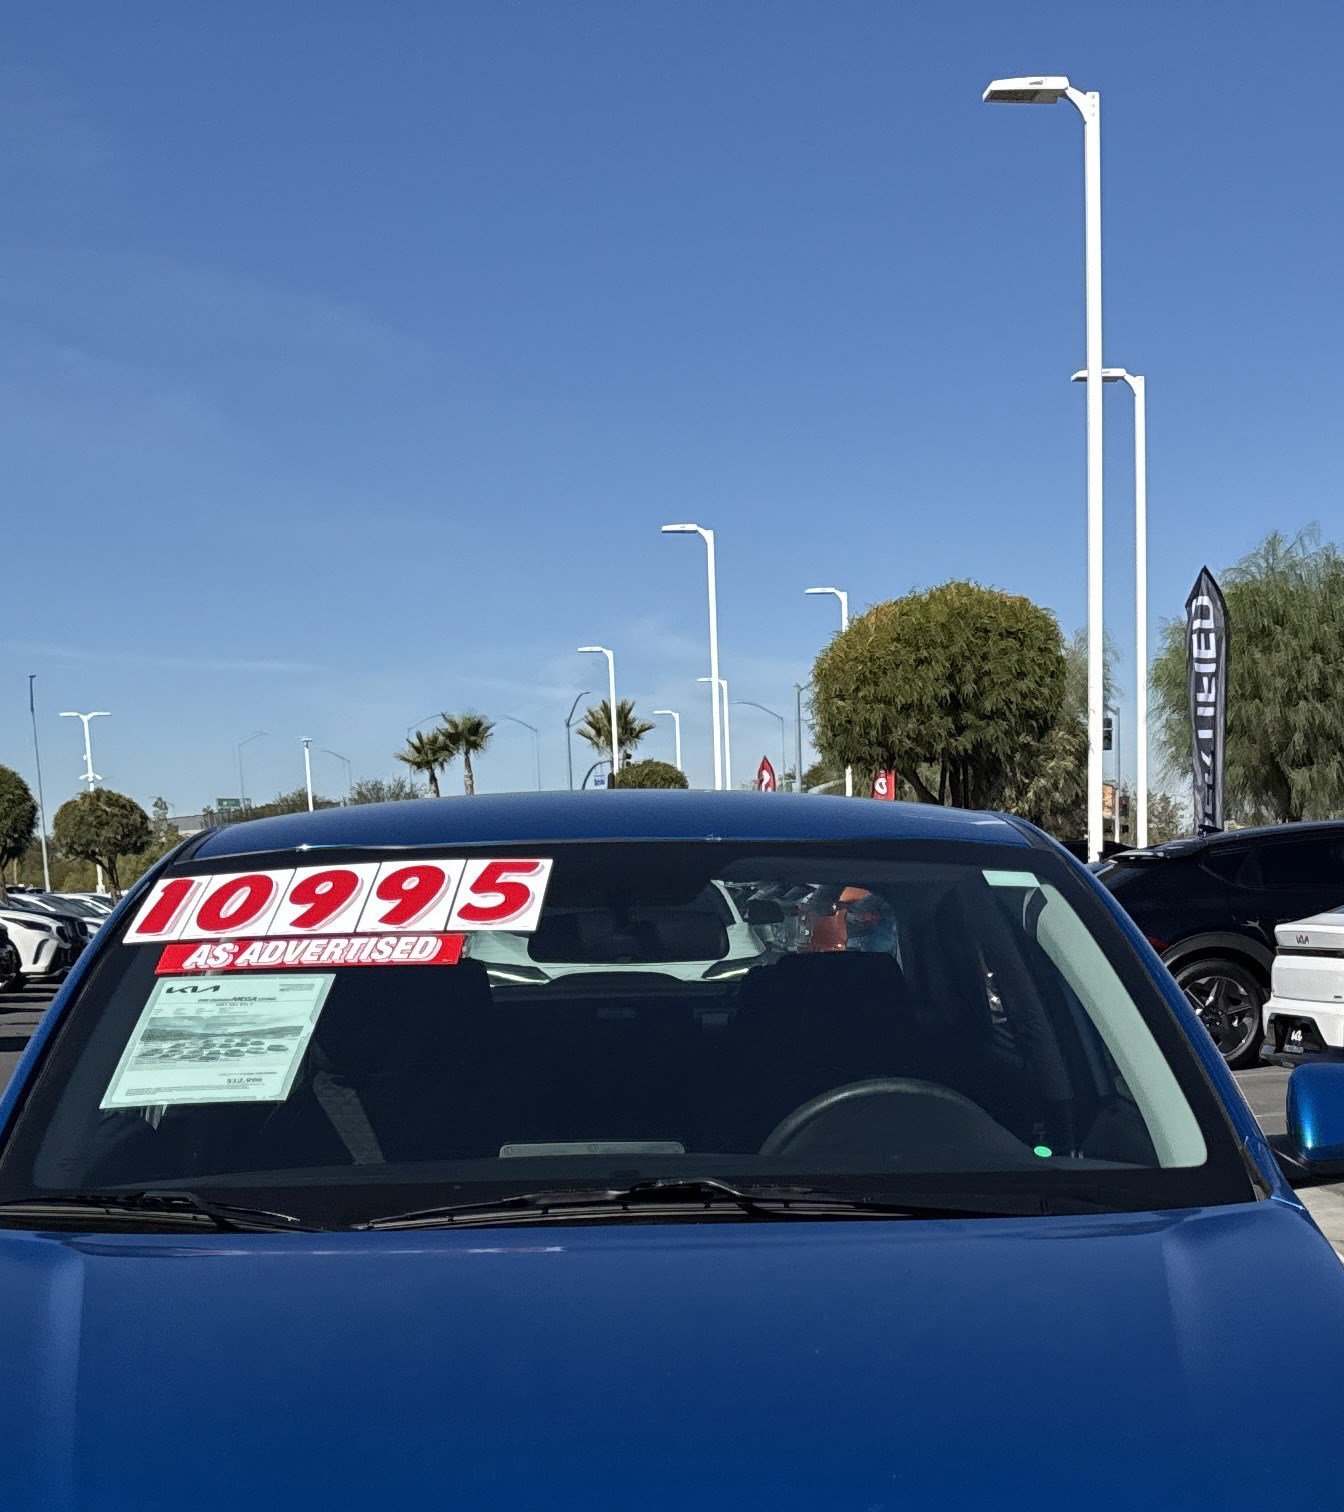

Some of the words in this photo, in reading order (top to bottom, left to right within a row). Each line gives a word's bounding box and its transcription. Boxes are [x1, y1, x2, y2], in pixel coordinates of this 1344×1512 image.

[135, 861, 544, 934] 10995
[184, 943, 234, 969] AS
[234, 935, 443, 966] ADVERTISED
[165, 984, 221, 994] KIA
